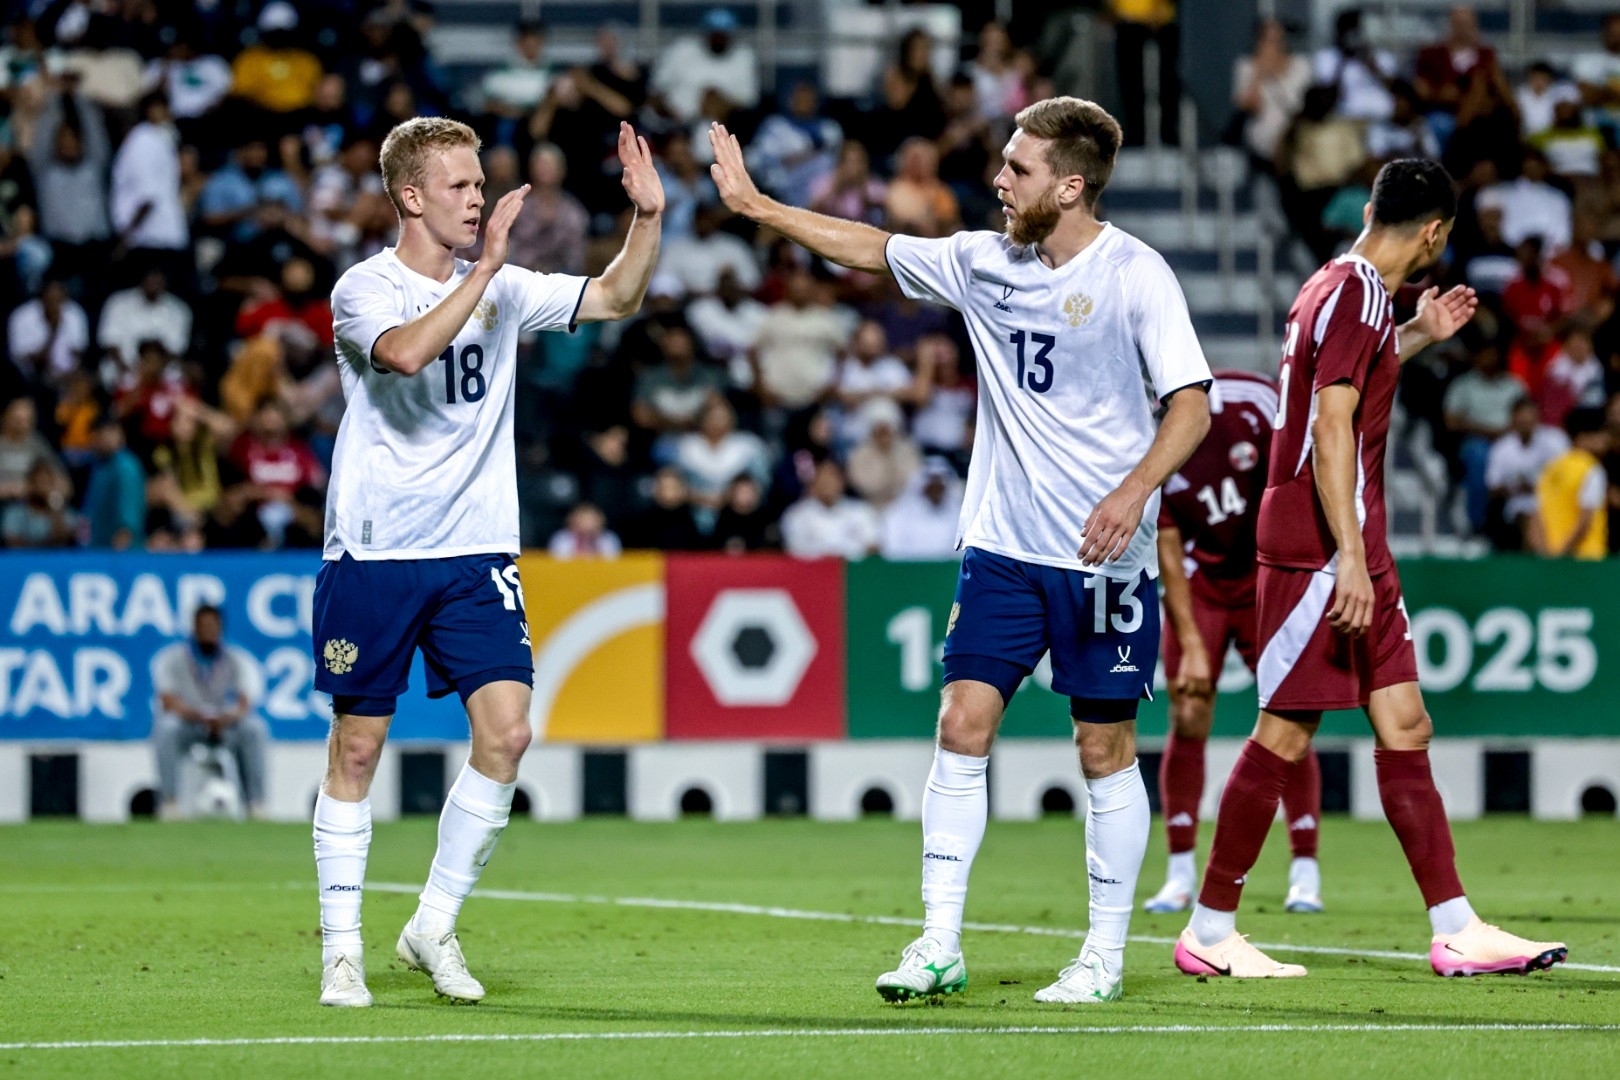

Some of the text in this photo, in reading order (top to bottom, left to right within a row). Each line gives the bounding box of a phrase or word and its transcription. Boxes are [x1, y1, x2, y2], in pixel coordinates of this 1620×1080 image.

[438, 343, 486, 404] 18
[1009, 329, 1056, 394] 13
[1196, 476, 1247, 526] 14
[1083, 573, 1144, 634] 13
[1109, 664, 1140, 673] JÖGEL
[1410, 606, 1598, 693] 025
